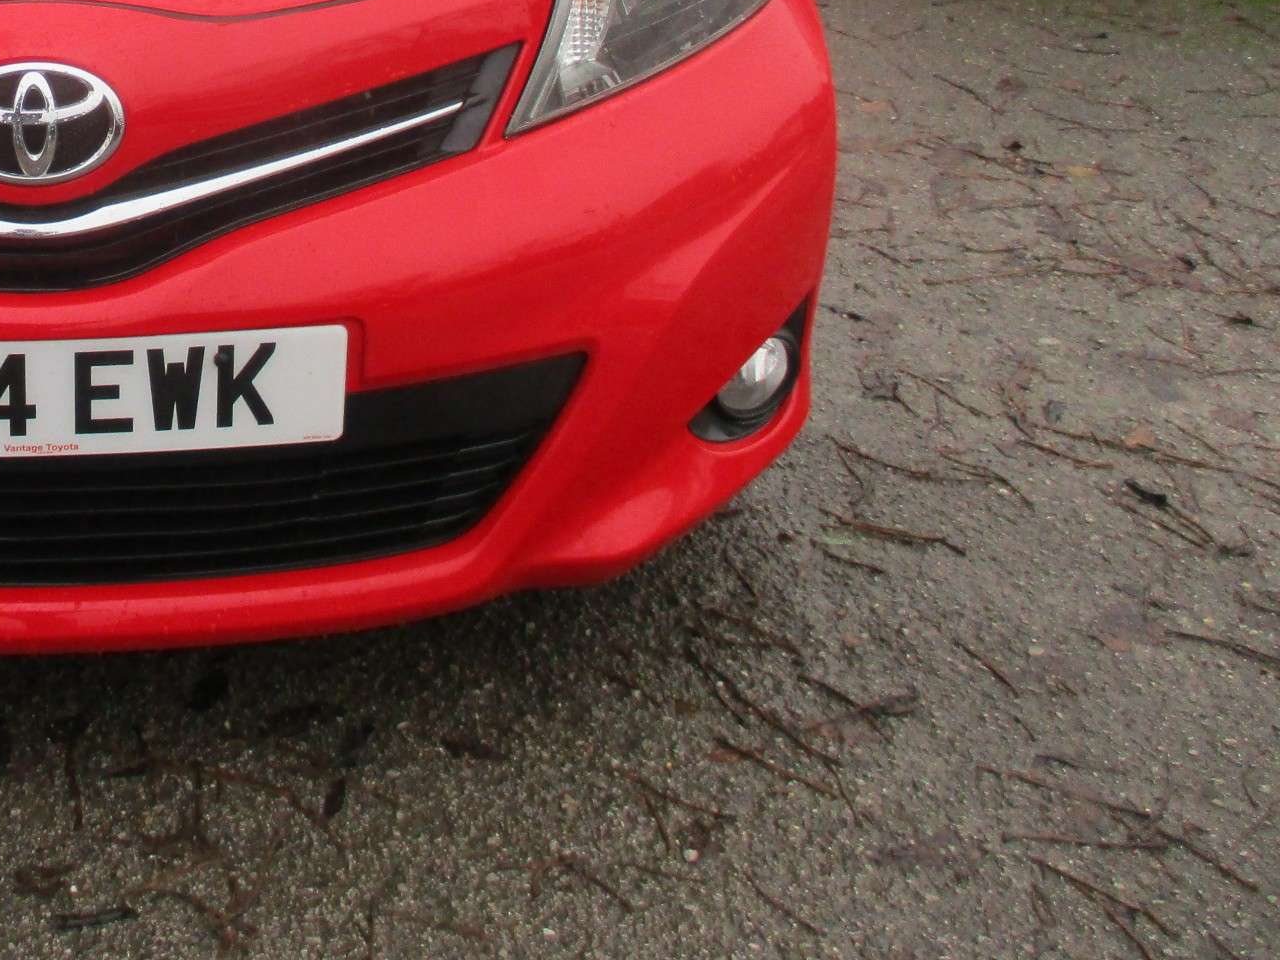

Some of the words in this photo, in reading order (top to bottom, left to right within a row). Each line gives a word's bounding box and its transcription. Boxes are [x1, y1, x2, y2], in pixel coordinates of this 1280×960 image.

[74, 341, 276, 434] EWK
[3, 442, 43, 454] Vantage
[45, 442, 79, 453] Toyota
